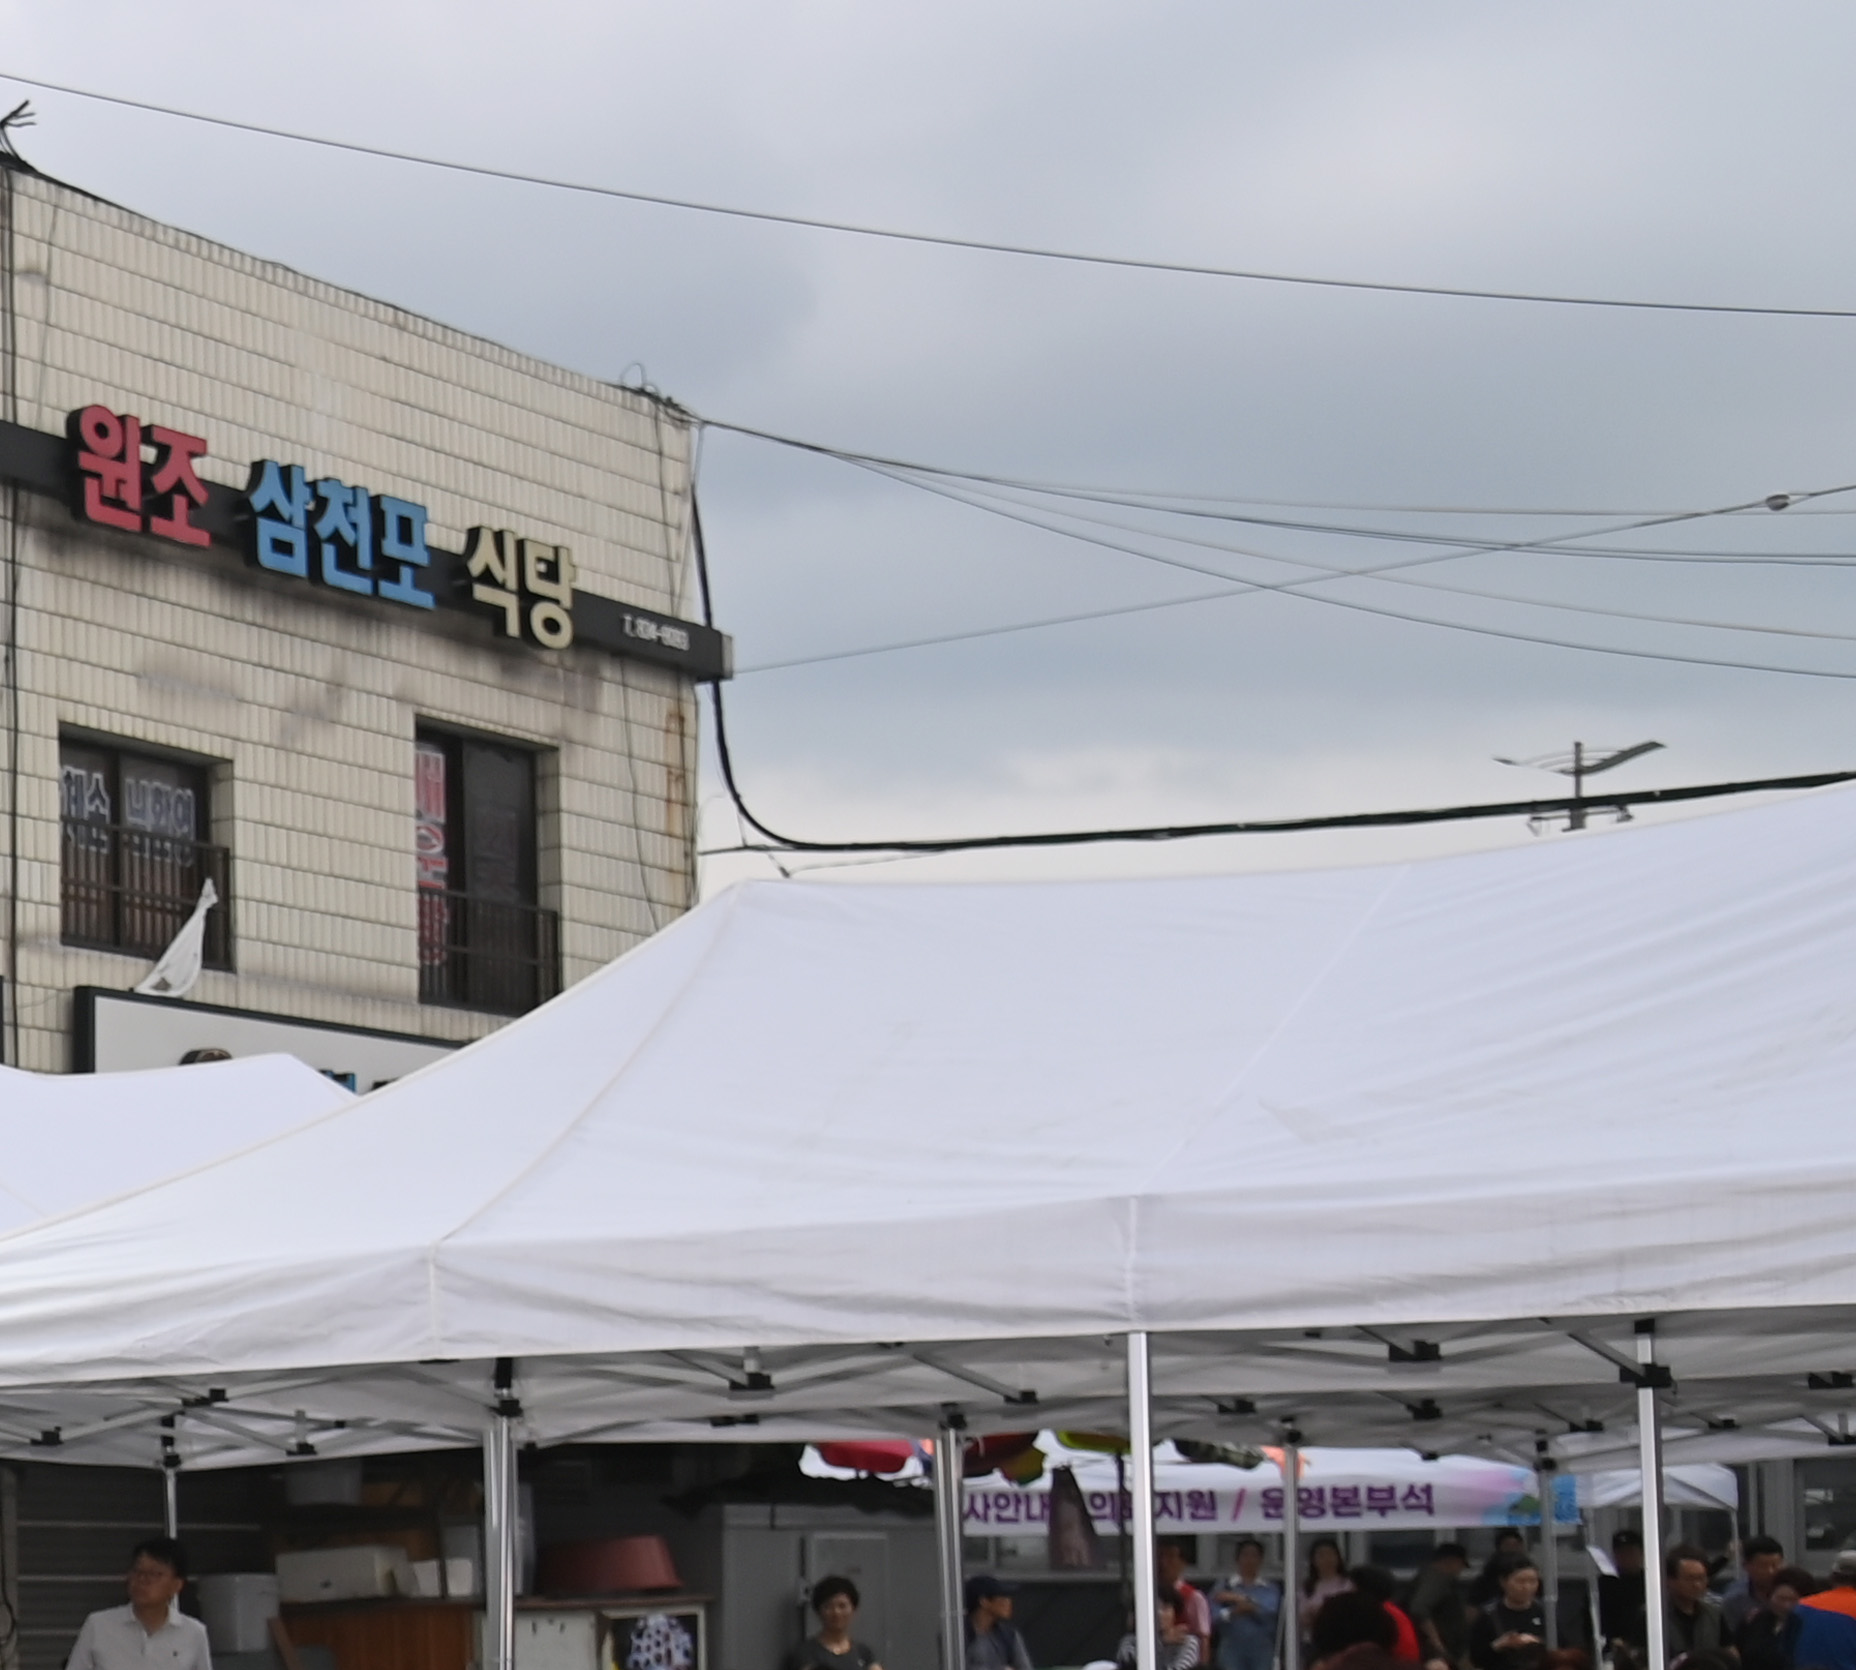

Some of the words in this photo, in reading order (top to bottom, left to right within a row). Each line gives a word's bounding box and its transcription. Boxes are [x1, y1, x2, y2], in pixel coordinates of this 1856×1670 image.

[78, 404, 211, 548] 원조
[249, 459, 435, 610] 삼천포
[467, 525, 575, 650] 식당
[1089, 1490, 1218, 1522] 의지원
[1261, 1484, 1435, 1519] 운영본부석
